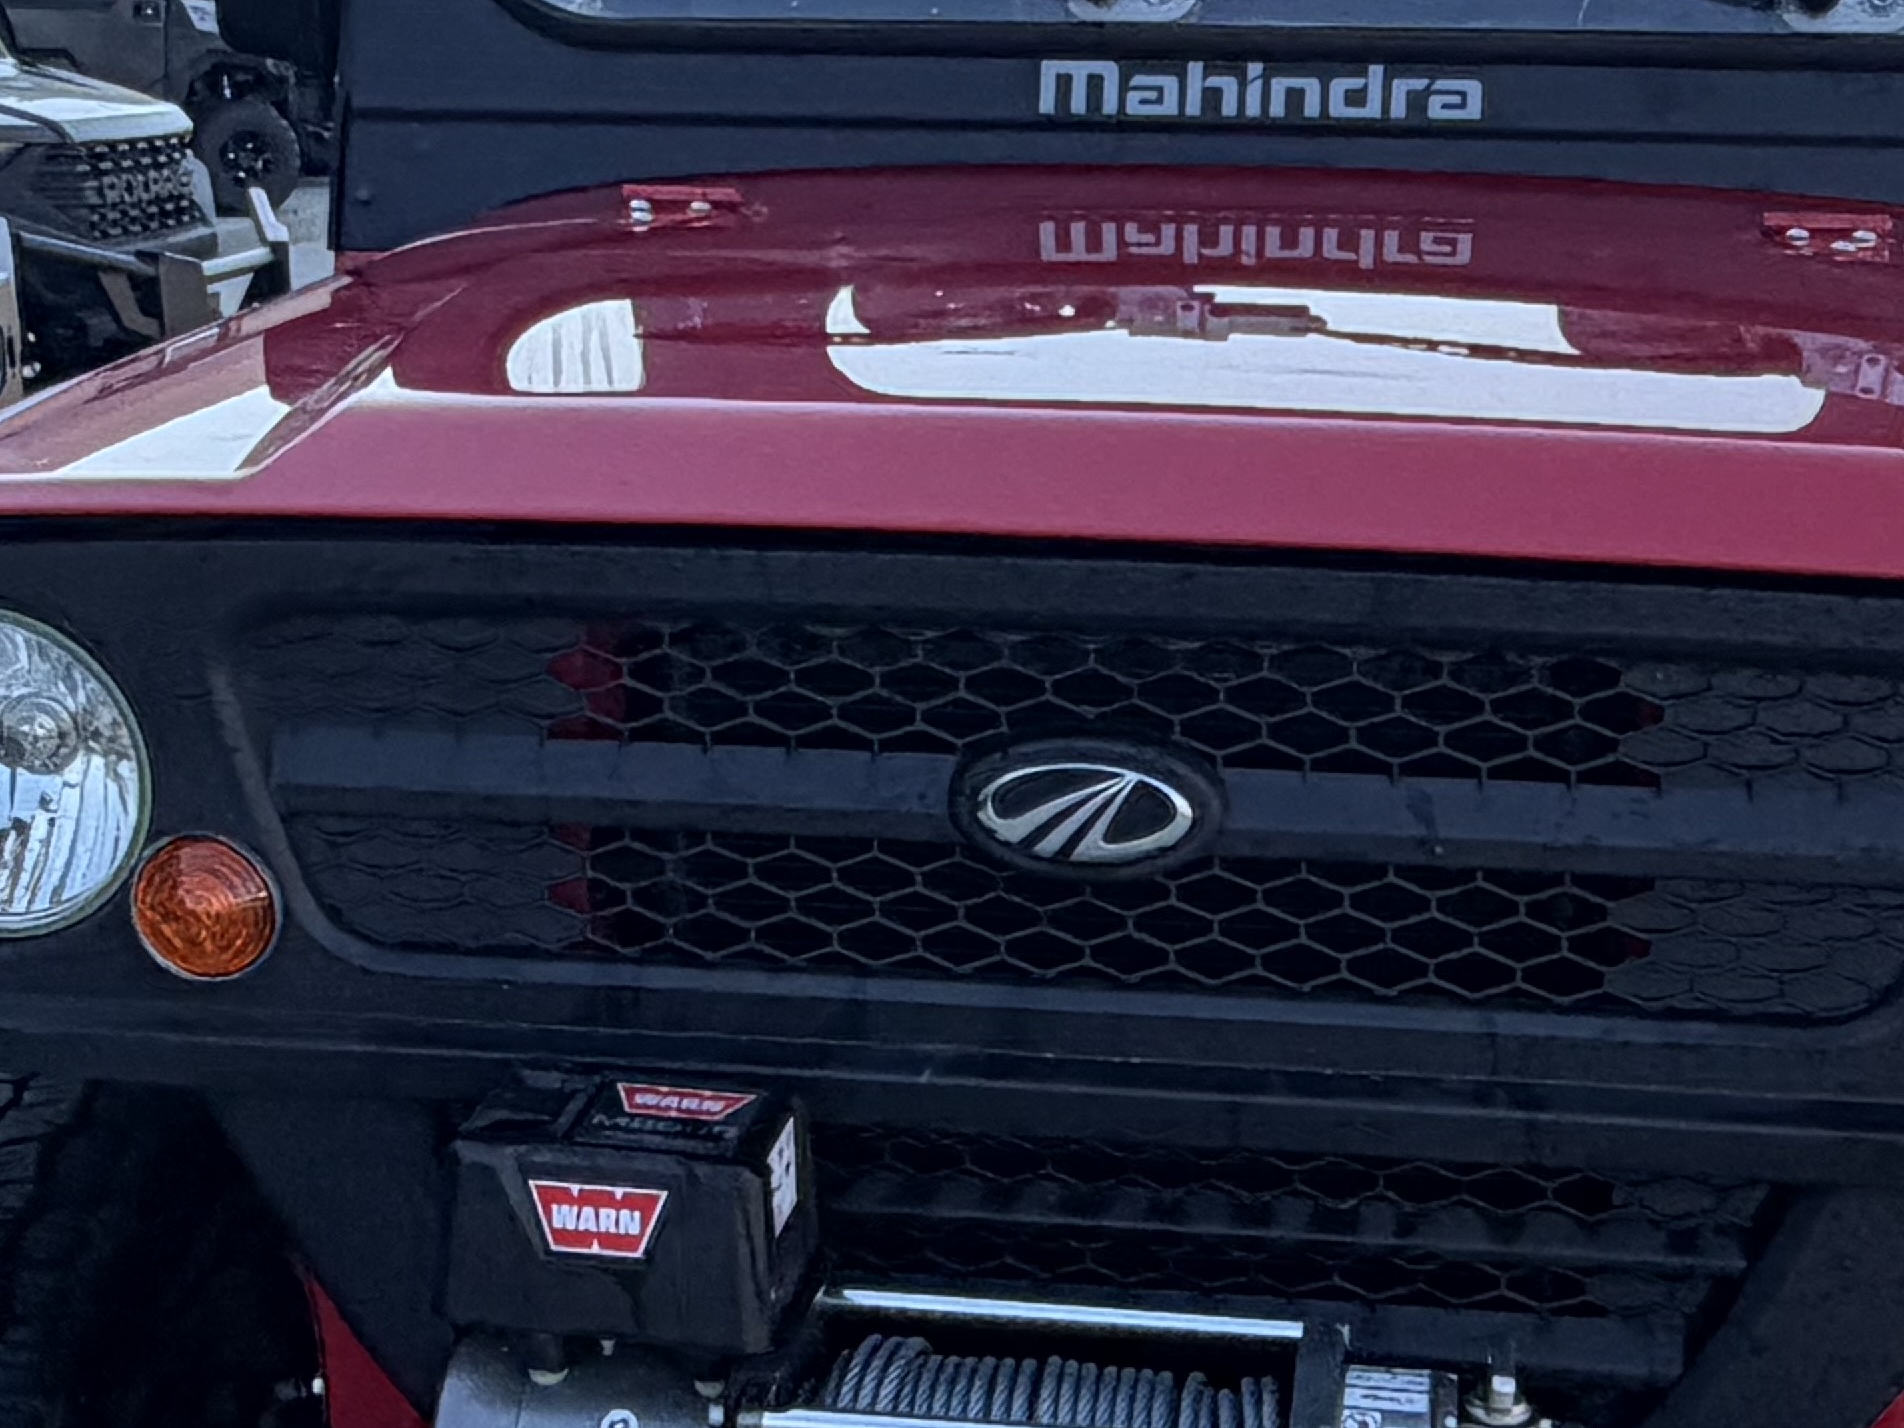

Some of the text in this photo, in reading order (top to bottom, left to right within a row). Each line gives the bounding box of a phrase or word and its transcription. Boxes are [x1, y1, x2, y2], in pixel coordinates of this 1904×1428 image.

[1039, 59, 1483, 120] Mahindra
[634, 1092, 725, 1113] WARN
[551, 1203, 641, 1236] WARN
